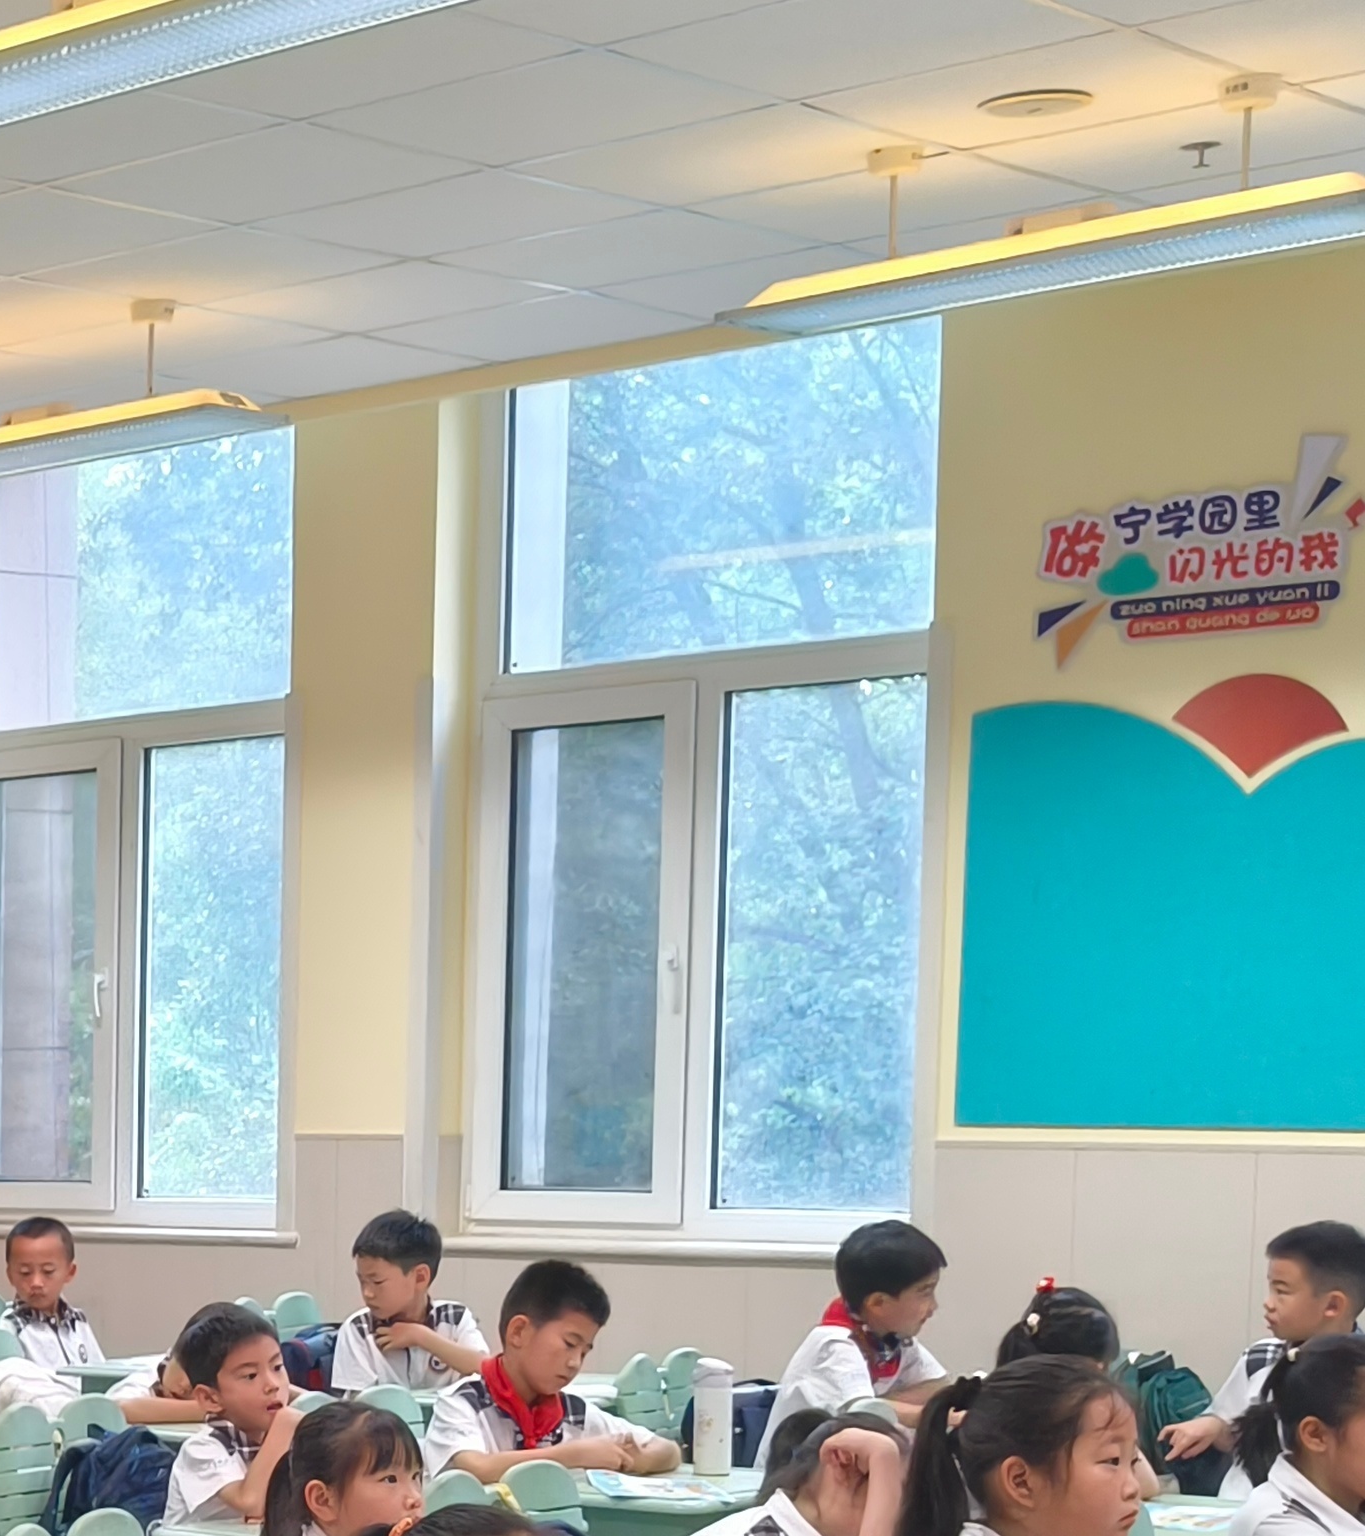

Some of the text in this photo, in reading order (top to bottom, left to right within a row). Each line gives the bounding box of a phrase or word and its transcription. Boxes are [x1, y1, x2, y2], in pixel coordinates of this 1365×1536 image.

[1114, 490, 1280, 545] 宁学园里
[1169, 532, 1339, 583] 闪光的我
